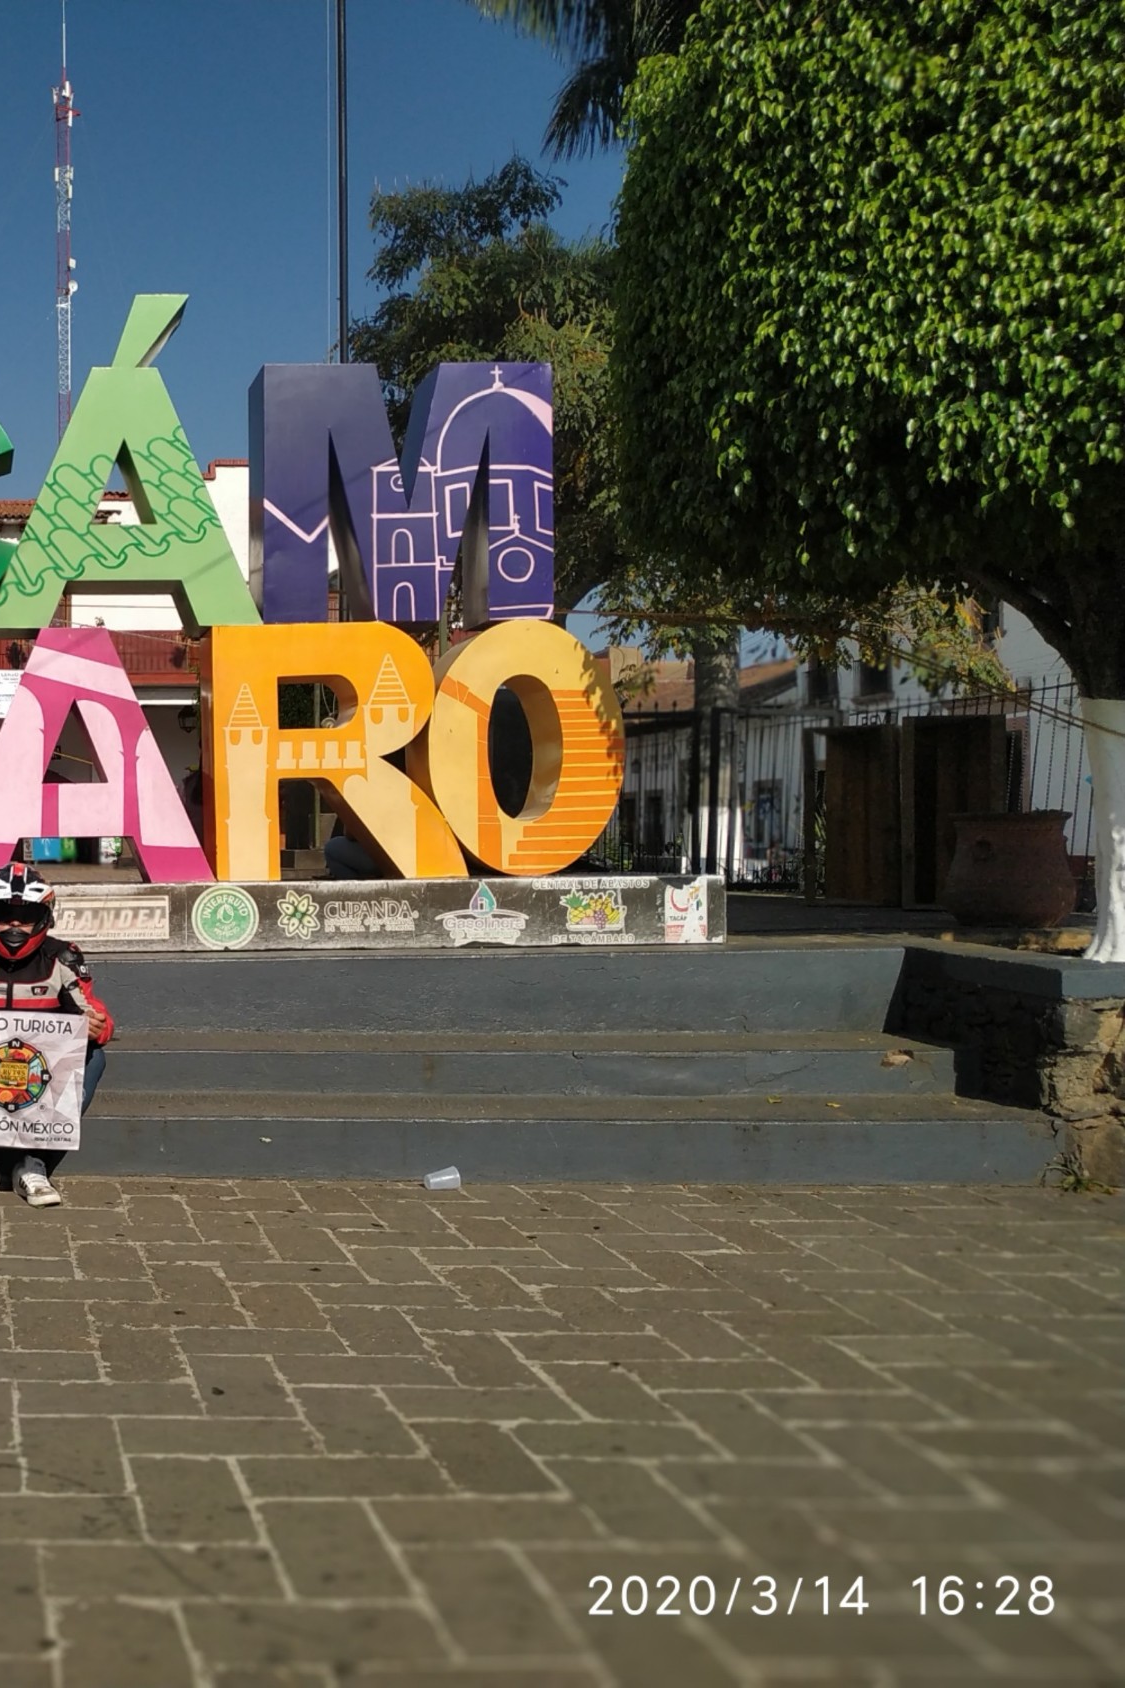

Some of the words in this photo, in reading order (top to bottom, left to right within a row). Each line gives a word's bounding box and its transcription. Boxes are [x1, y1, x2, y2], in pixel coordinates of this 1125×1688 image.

[532, 879, 581, 889] CENTRAL
[583, 879, 599, 889] DE
[600, 878, 650, 889] ABASTOS
[202, 894, 249, 919] INTERFRUTO
[323, 900, 412, 919] CUPANDA
[443, 916, 526, 931] Gasolinera
[552, 935, 567, 944] DE
[569, 931, 635, 944] TACÁMBARO
[12, 1017, 73, 1035] TURISTA
[22, 1119, 74, 1134] MÉXICO
